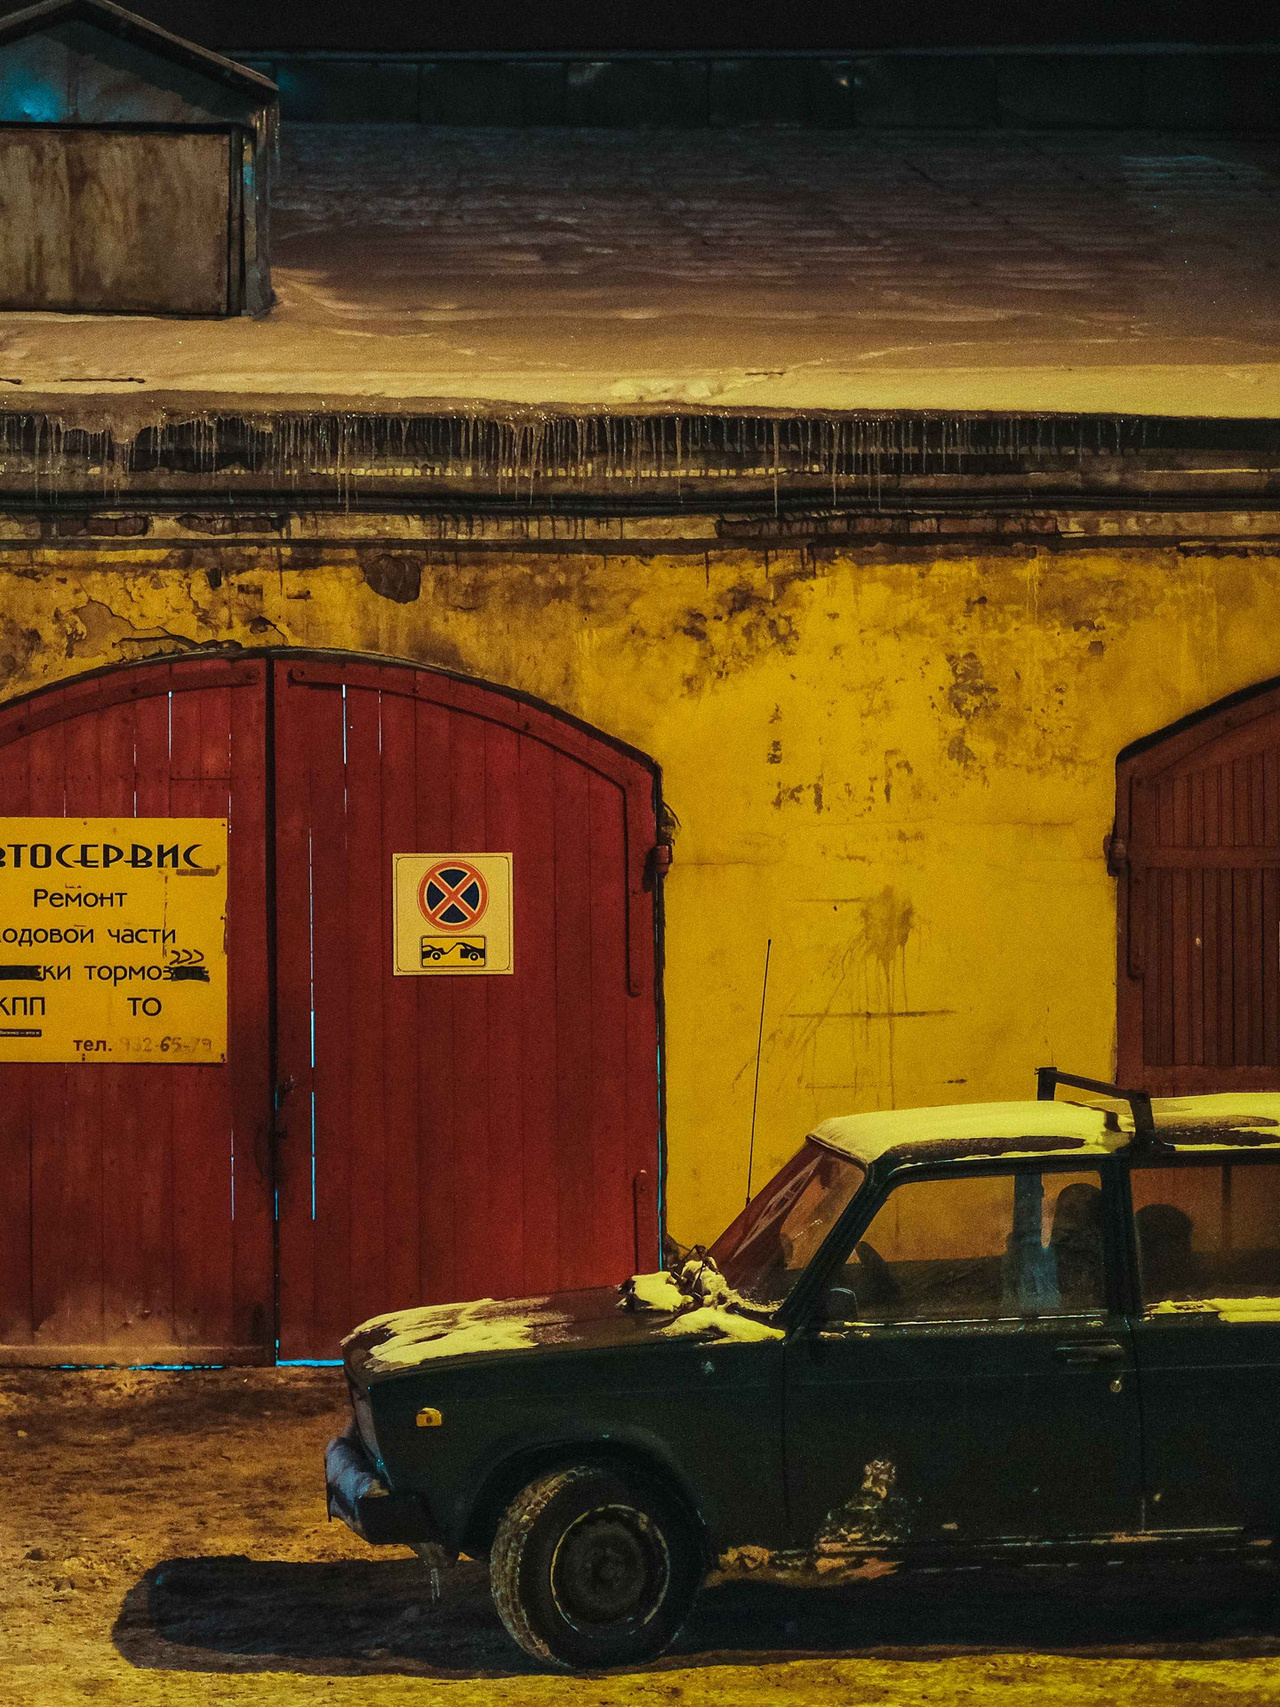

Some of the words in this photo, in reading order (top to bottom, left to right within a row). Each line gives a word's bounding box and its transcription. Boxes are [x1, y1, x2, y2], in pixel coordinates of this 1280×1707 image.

[33, 888, 128, 907] Ремонт
[107, 927, 176, 944] части
[127, 997, 162, 1017] ТО
[72, 1039, 112, 1052] тел.
